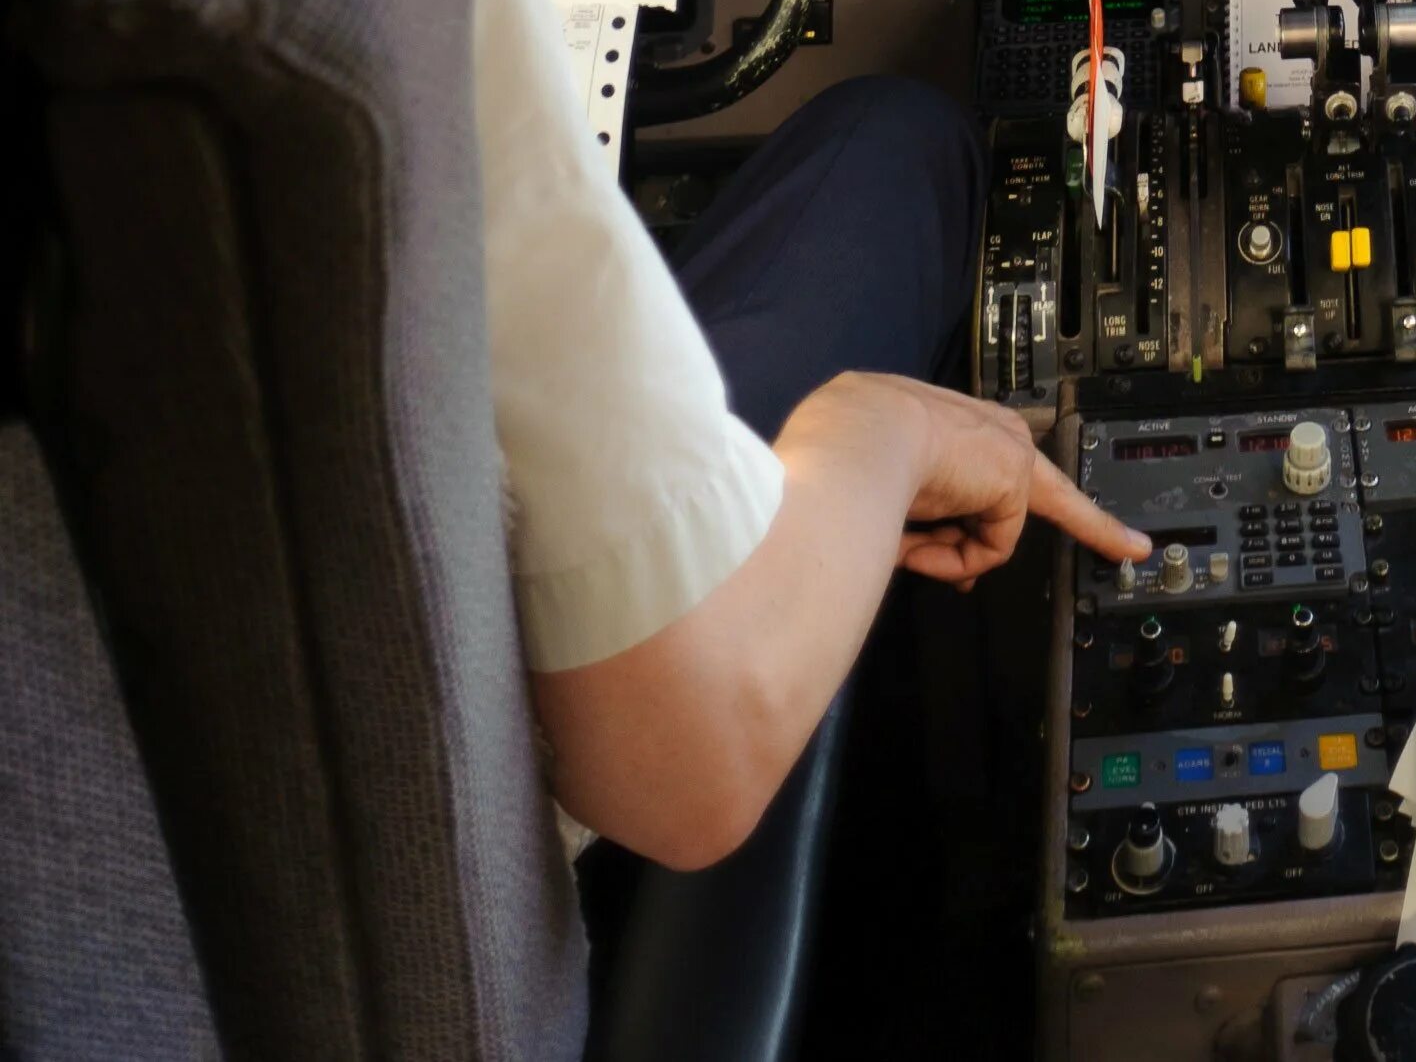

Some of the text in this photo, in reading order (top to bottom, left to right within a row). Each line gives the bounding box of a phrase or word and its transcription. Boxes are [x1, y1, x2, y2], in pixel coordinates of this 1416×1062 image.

[1249, 42, 1282, 55] LAN
[1326, 170, 1365, 181] LONG TRIM
[1315, 203, 1335, 212] NOSE
[1157, 217, 1163, 227] 8
[1032, 230, 1053, 242] FLAP
[1268, 265, 1286, 274] FULL
[1154, 278, 1164, 290] 12
[1320, 299, 1339, 308] NOSE
[1104, 315, 1126, 326] LONG
[1105, 326, 1127, 338] TRIM
[1138, 340, 1160, 351] NOSE
[1144, 351, 1156, 362] UP
[1257, 414, 1298, 425] STANDBY
[1138, 422, 1170, 432] ACTIVE
[1213, 709, 1242, 720] NORM
[1245, 801, 1264, 810] PED
[1285, 867, 1305, 879] OFF
[1195, 883, 1213, 894] OFF
